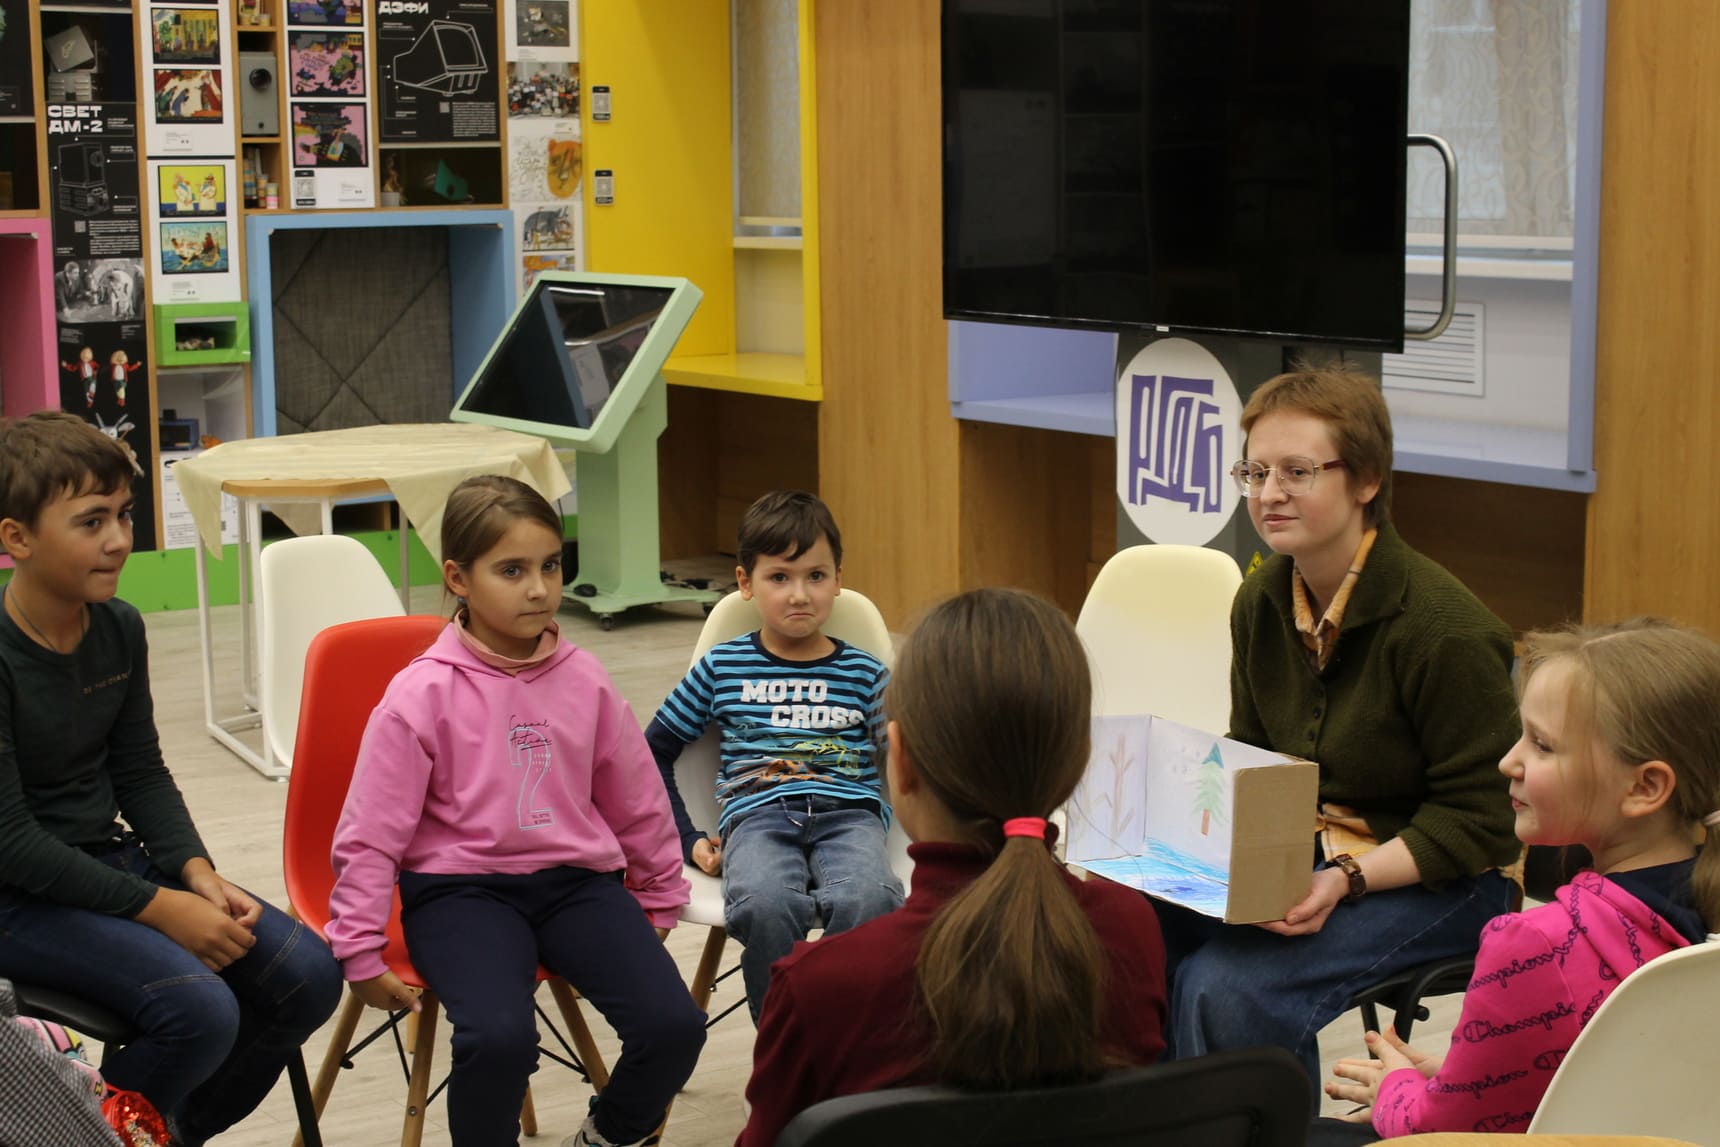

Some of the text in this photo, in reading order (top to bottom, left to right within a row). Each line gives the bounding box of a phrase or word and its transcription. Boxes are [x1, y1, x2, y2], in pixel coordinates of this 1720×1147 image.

[378, 1, 429, 15] ДЭФИ
[47, 105, 103, 118] СВЕТ
[48, 120, 104, 135] ДМ-2
[740, 679, 828, 703] MOTO
[771, 704, 866, 729] CROSS
